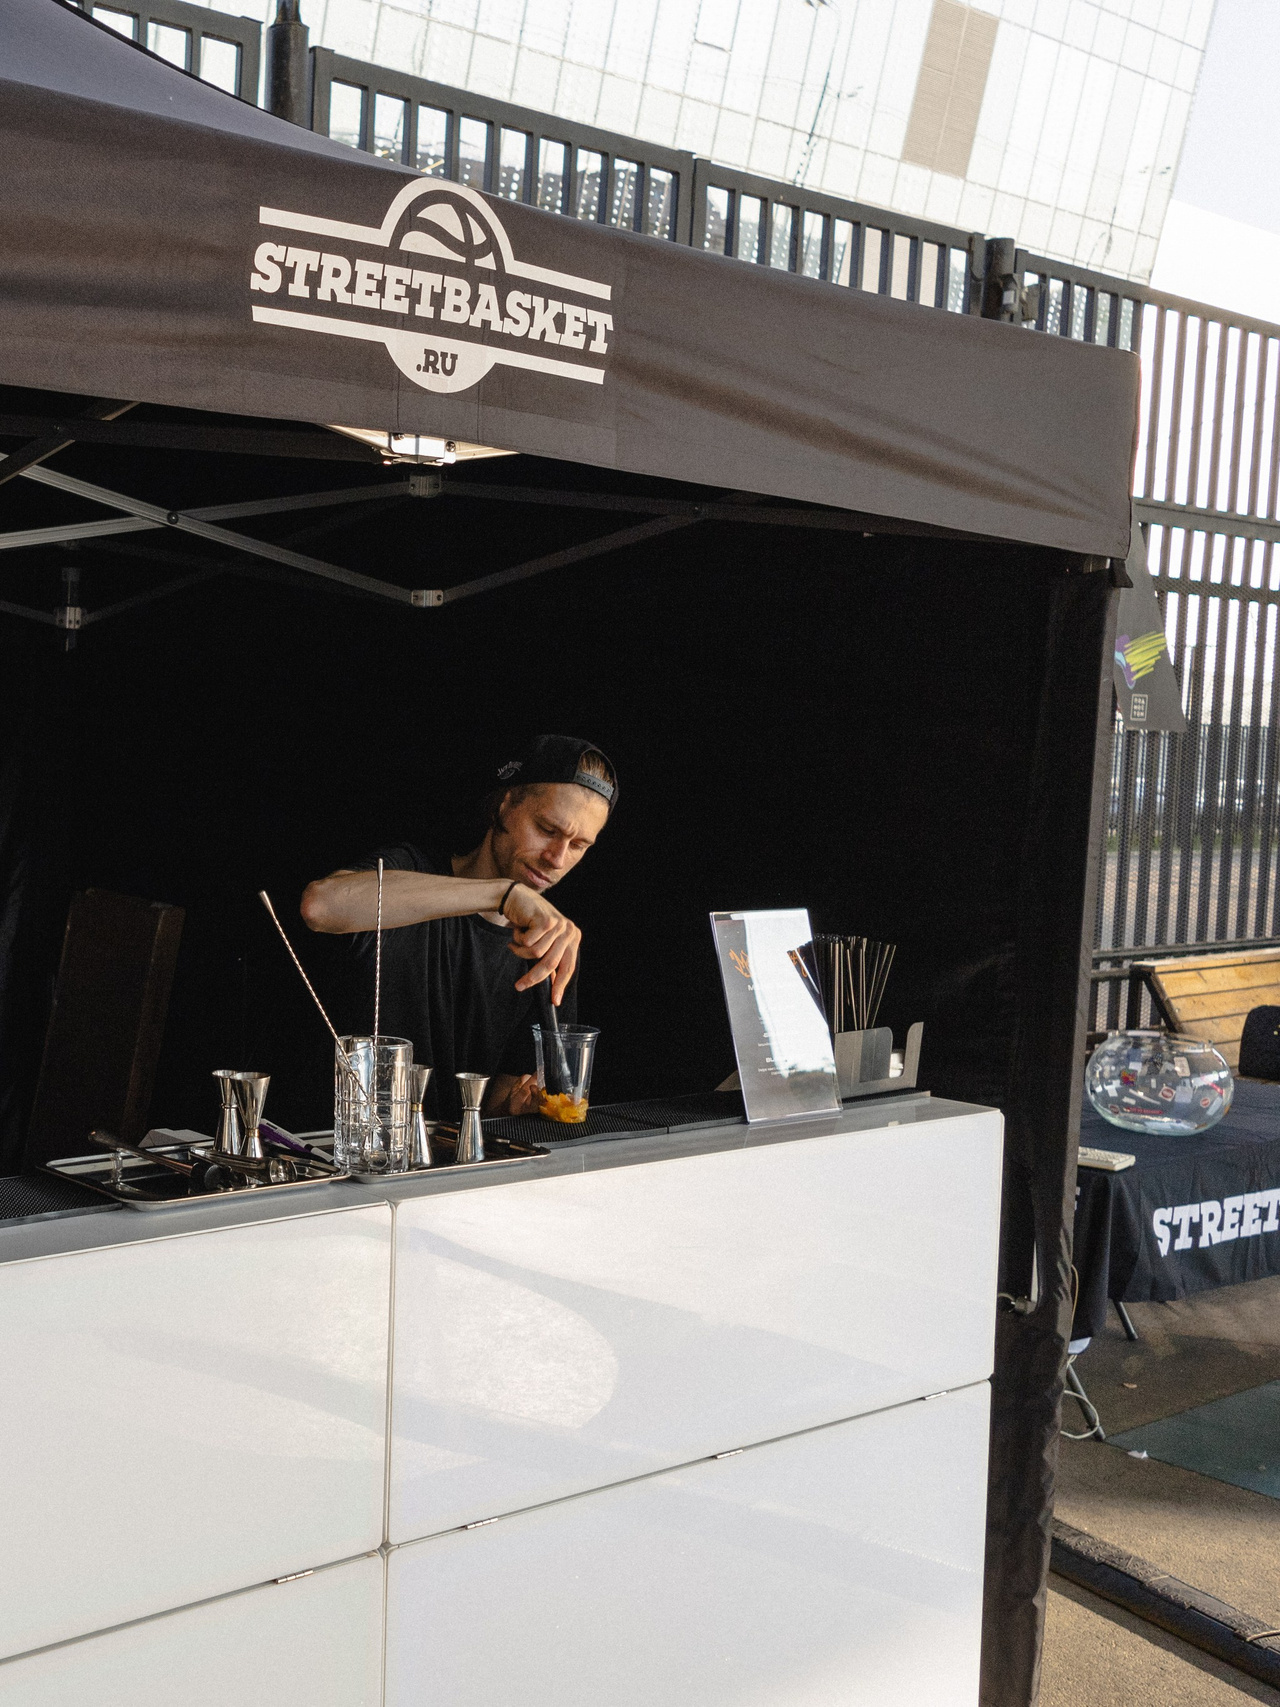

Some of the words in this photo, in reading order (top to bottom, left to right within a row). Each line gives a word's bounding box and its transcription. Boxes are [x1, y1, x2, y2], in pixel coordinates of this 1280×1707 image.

[250, 242, 614, 354] STREETBASKET
[415, 348, 458, 377] .RU
[1153, 1188, 1280, 1258] STREET
